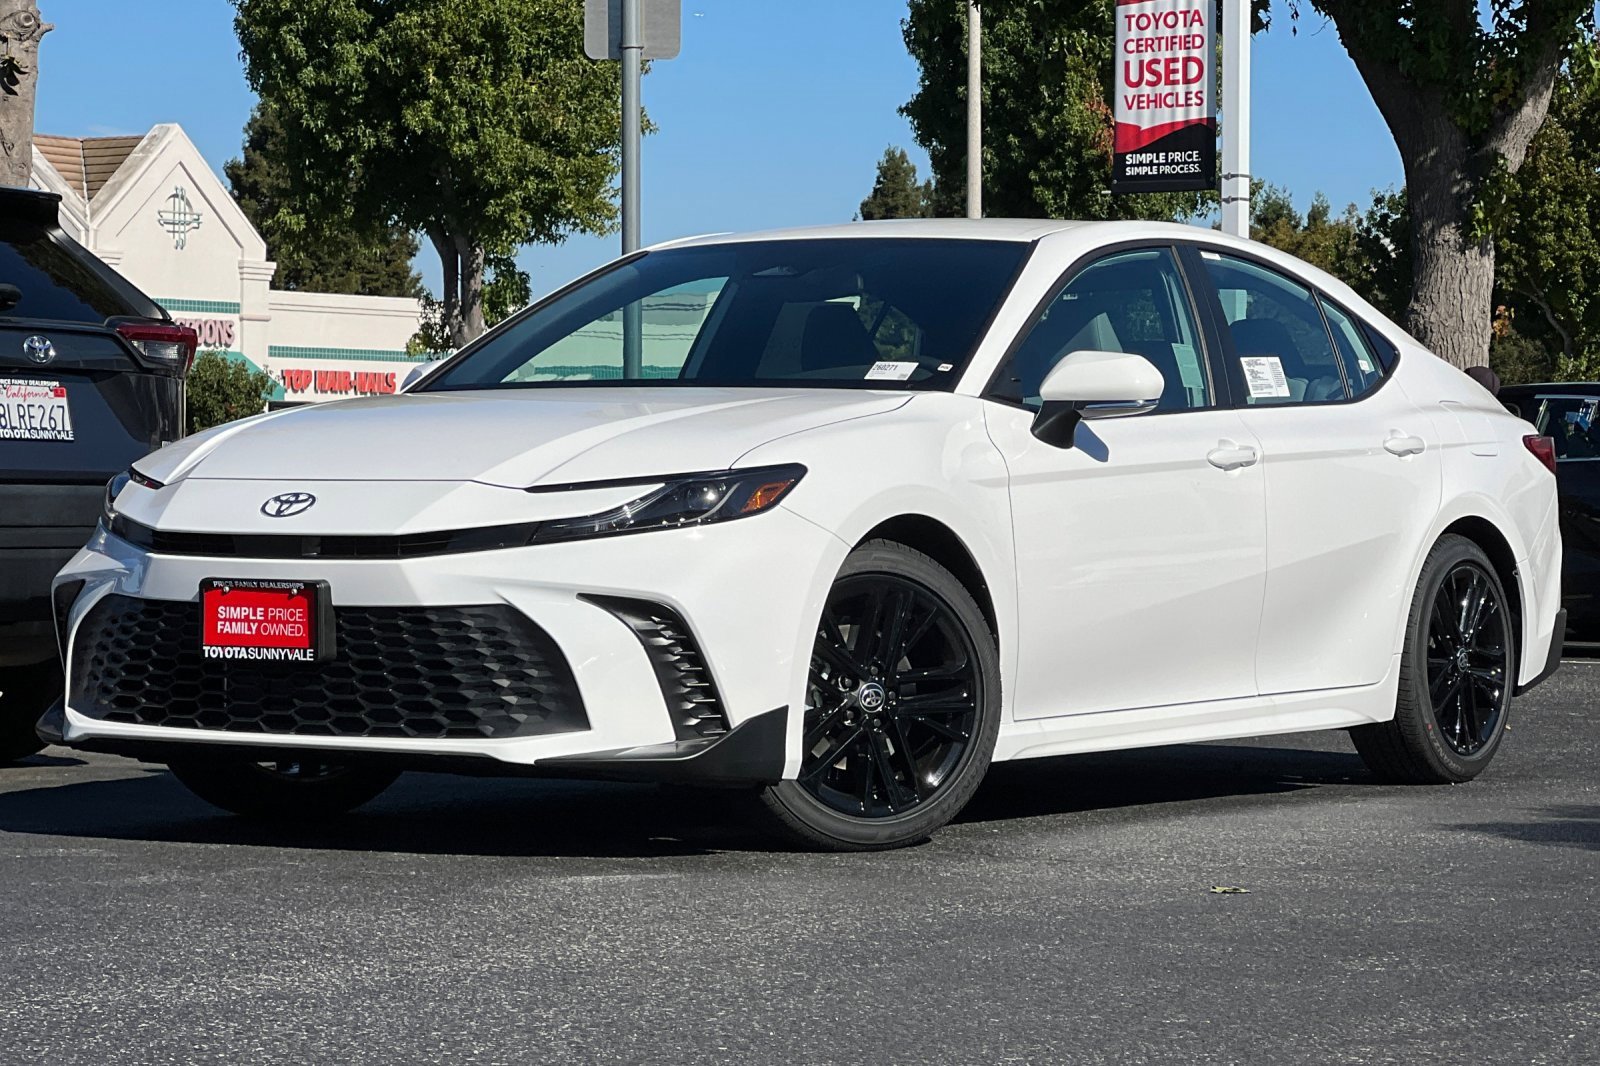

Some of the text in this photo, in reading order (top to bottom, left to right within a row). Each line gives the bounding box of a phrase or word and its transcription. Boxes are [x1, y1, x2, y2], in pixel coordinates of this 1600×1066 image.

[1124, 9, 1204, 32] TOYOTA
[1123, 34, 1205, 54] CERTIFIED
[1124, 56, 1204, 88] USED
[1123, 90, 1204, 110] VEHICLES
[1125, 150, 1202, 165] SIMPLE PRICE.
[1125, 163, 1202, 176] SIMPLE PROCESS.
[283, 369, 312, 391] TOP
[6, 385, 54, 402] California
[213, 580, 234, 588] PRICE
[260, 582, 305, 590] DEALERSHIPS
[217, 606, 306, 622] SIMPLE PRICE.
[217, 621, 306, 637] FAMILY OWNED.
